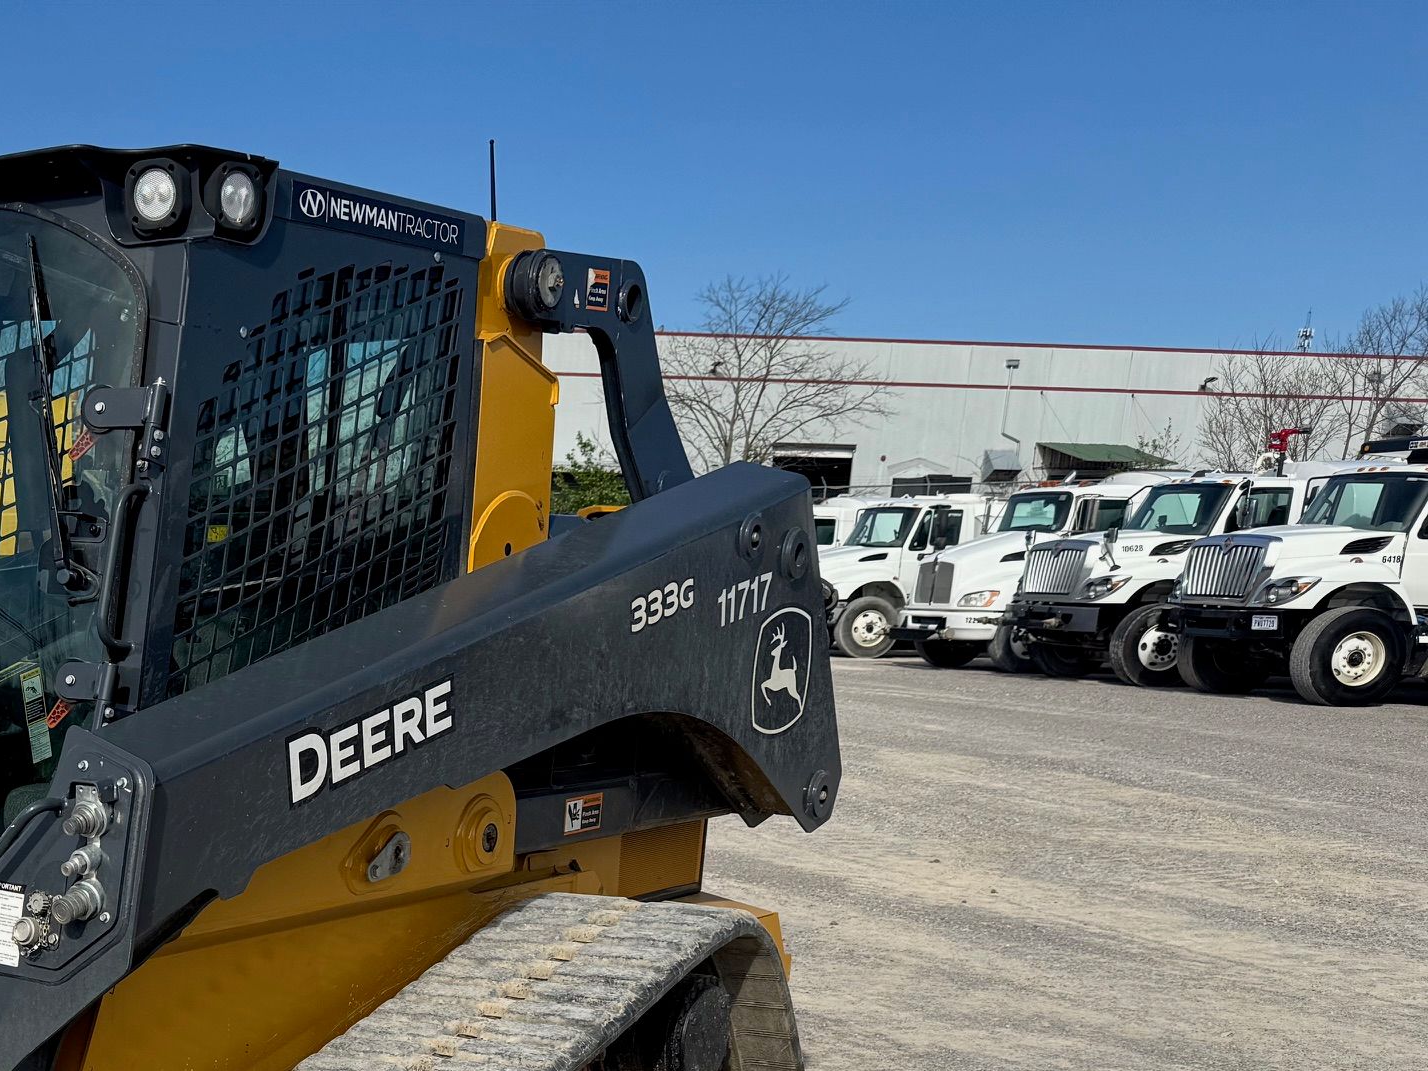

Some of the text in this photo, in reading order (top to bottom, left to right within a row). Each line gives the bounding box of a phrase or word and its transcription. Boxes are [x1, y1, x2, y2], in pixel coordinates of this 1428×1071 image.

[330, 196, 459, 245] NEWMANTRACTOR
[1122, 544, 1144, 553] 10628
[631, 578, 694, 633] 333G
[717, 571, 773, 628] 11717
[288, 680, 453, 804] DEERE
